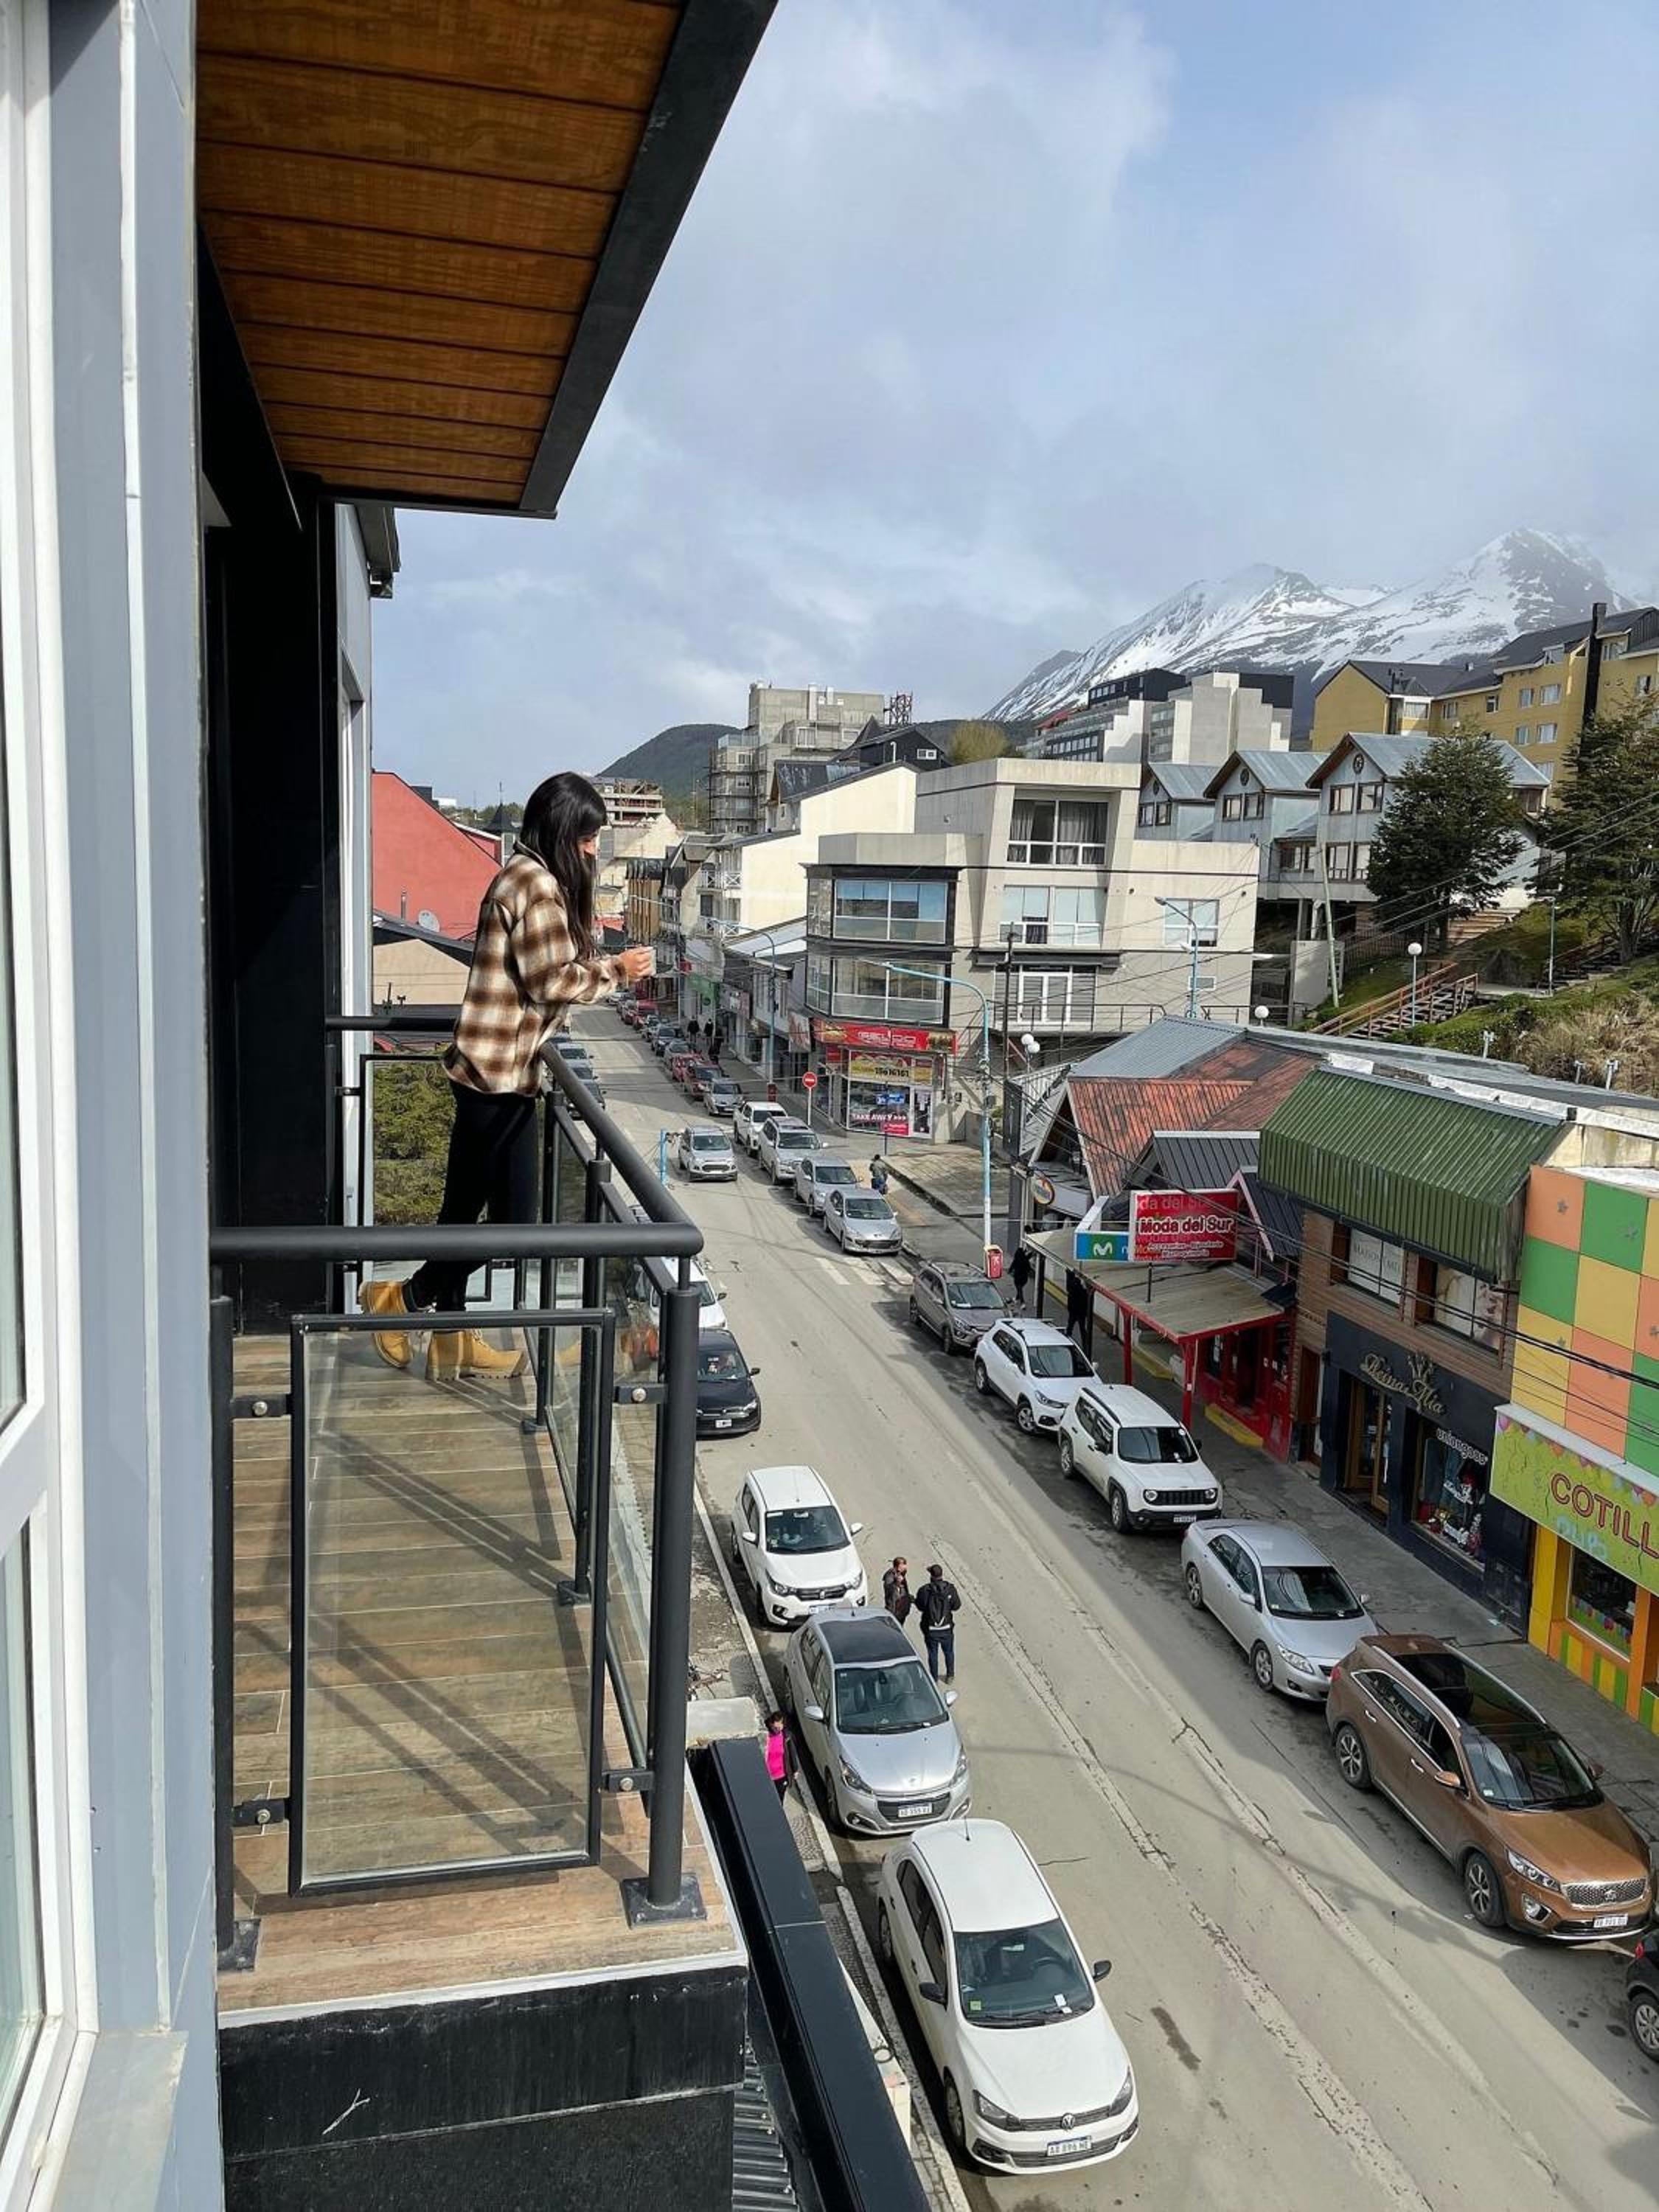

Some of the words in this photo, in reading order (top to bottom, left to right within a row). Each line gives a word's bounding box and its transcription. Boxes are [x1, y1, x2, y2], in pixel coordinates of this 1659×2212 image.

[1139, 1218, 1180, 1234] Moda
[1181, 1216, 1205, 1234] del
[1206, 1215, 1235, 1233] Sur
[1551, 1473, 1659, 1559] COTILL
